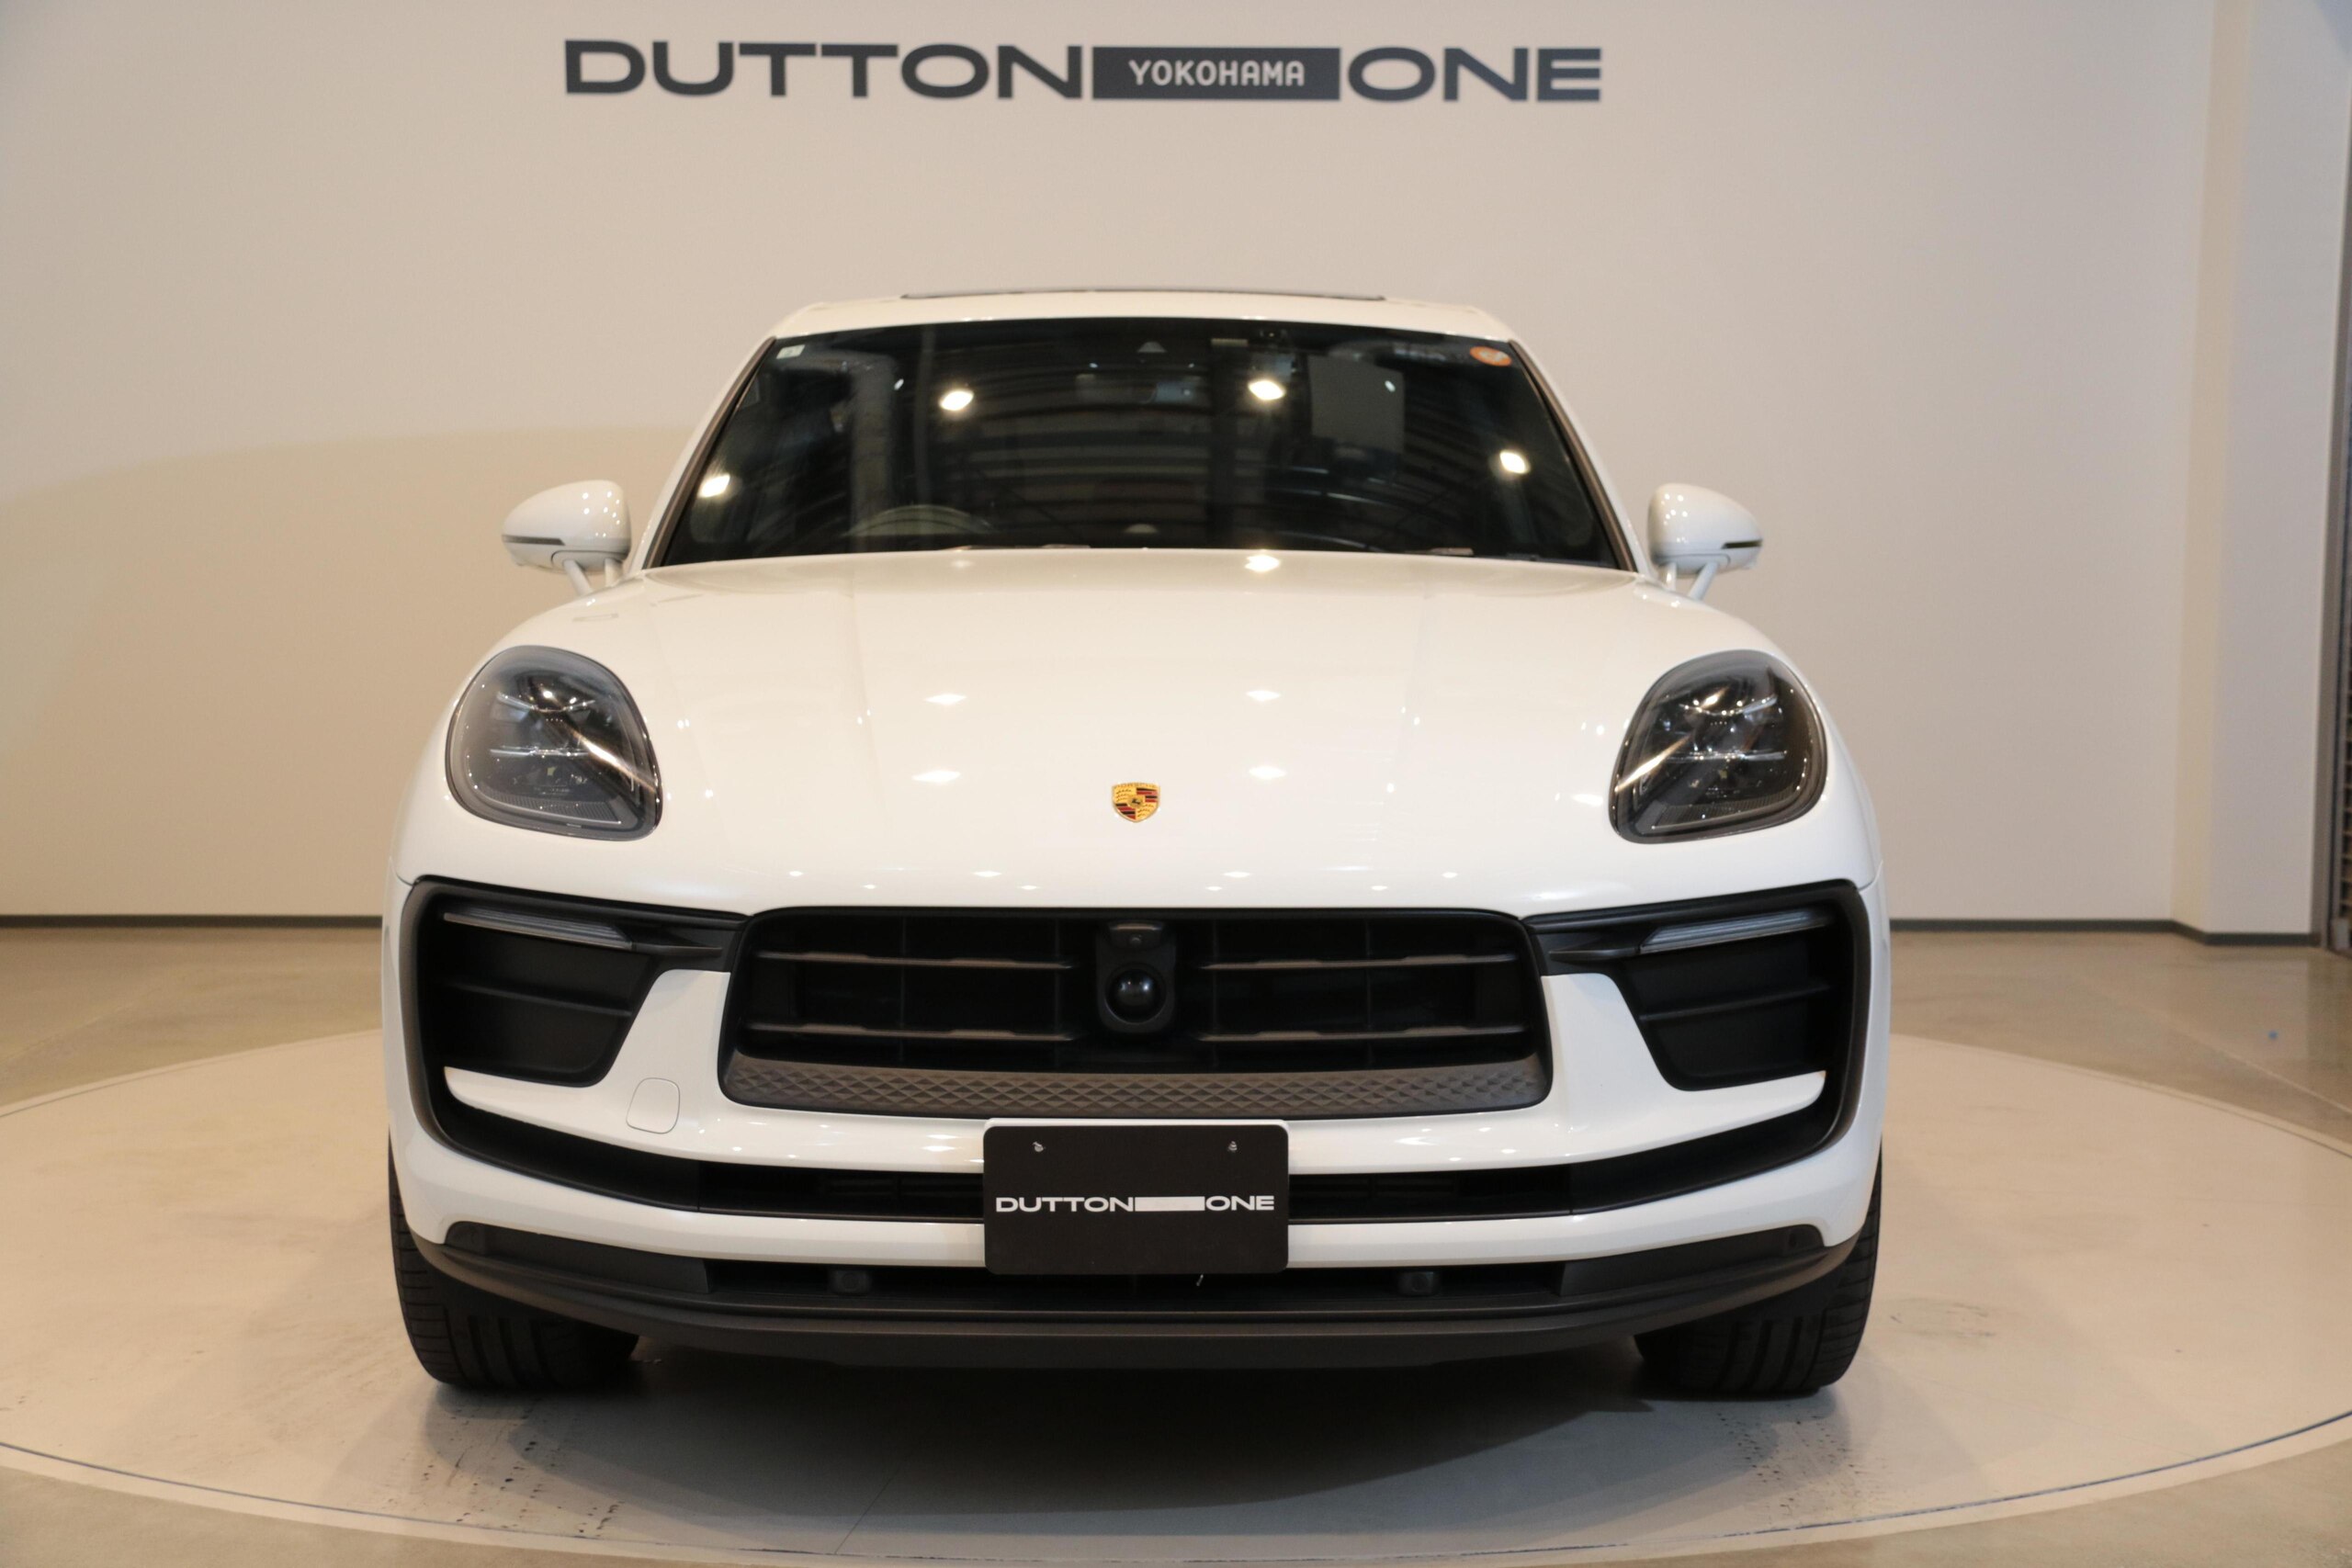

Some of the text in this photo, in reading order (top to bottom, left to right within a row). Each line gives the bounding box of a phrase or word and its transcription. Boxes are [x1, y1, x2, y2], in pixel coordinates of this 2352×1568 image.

[564, 39, 1601, 102] DUTTON YOKOHAMA ONE
[995, 1195, 1275, 1213] DUTTON ONE
